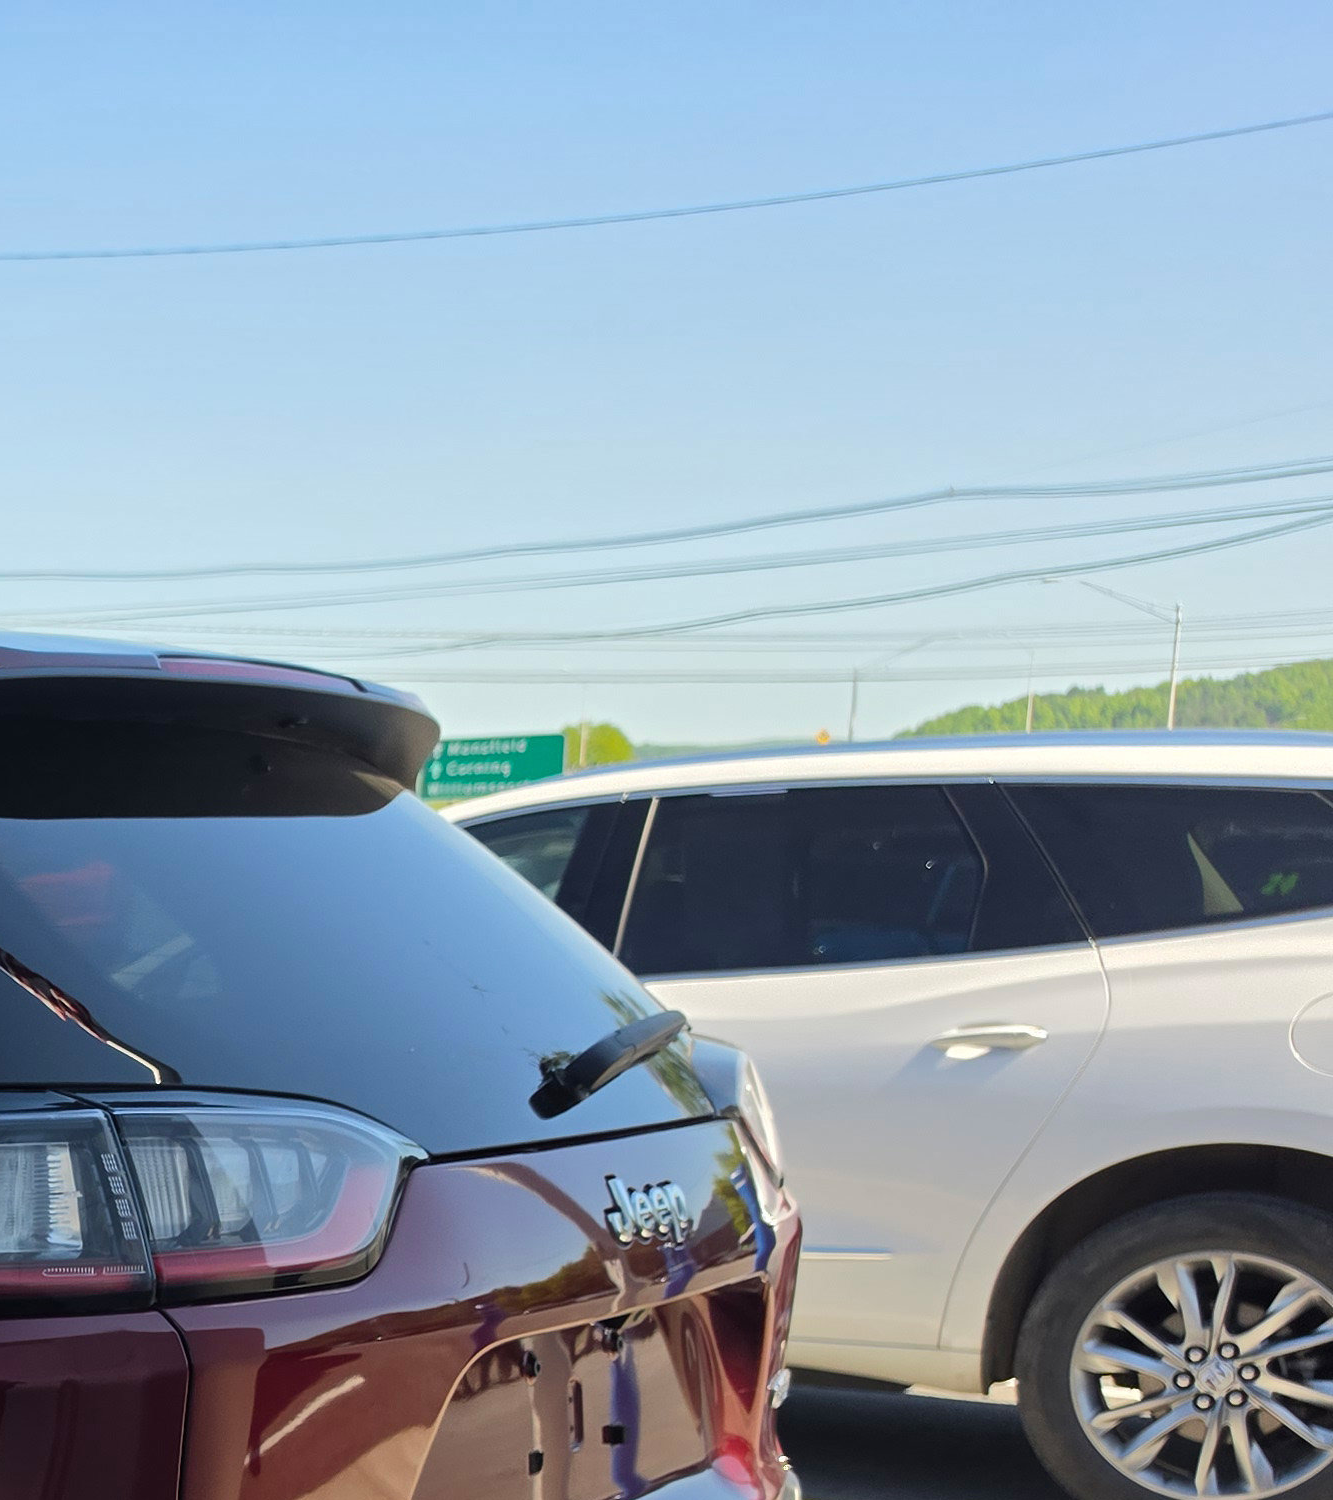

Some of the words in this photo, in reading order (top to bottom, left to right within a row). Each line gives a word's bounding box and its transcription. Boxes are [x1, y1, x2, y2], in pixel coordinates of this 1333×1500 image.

[447, 738, 528, 756] Mansfield
[446, 759, 511, 778] Corning
[428, 781, 532, 797] Williamspo
[604, 1174, 691, 1248] Jeep
